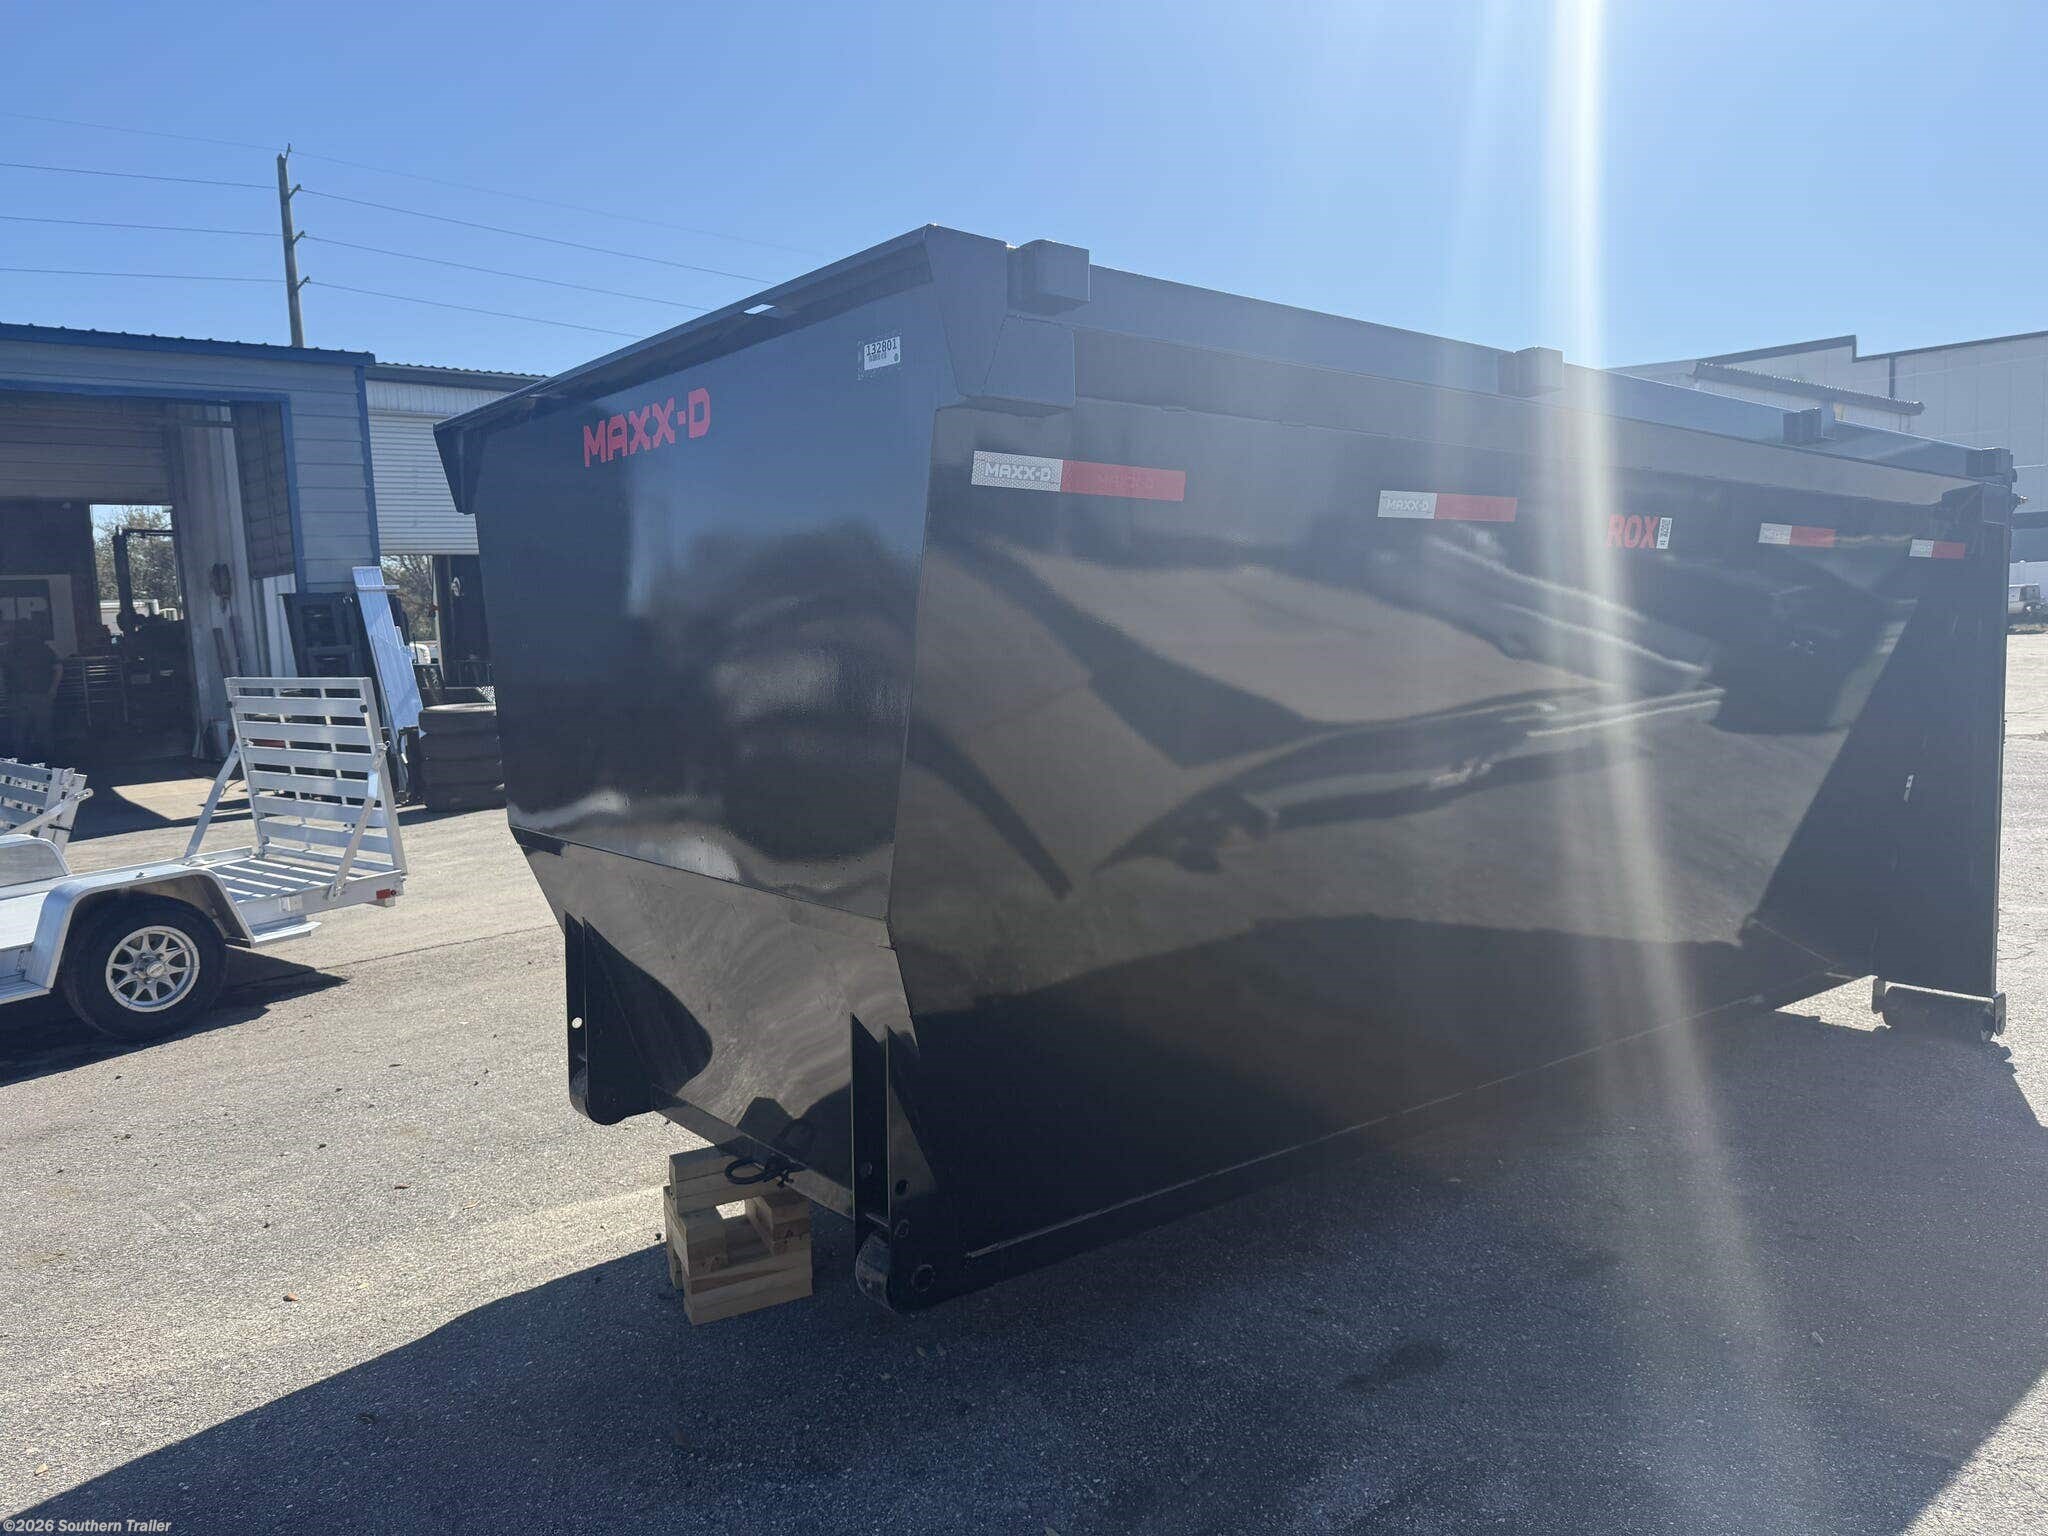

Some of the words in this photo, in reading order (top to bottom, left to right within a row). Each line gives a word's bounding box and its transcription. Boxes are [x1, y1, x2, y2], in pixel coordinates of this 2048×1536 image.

[866, 339, 897, 356] 132801
[583, 387, 711, 467] MAXX-D
[984, 462, 1051, 481] MAXX-D
[1605, 514, 1659, 549] ROX
